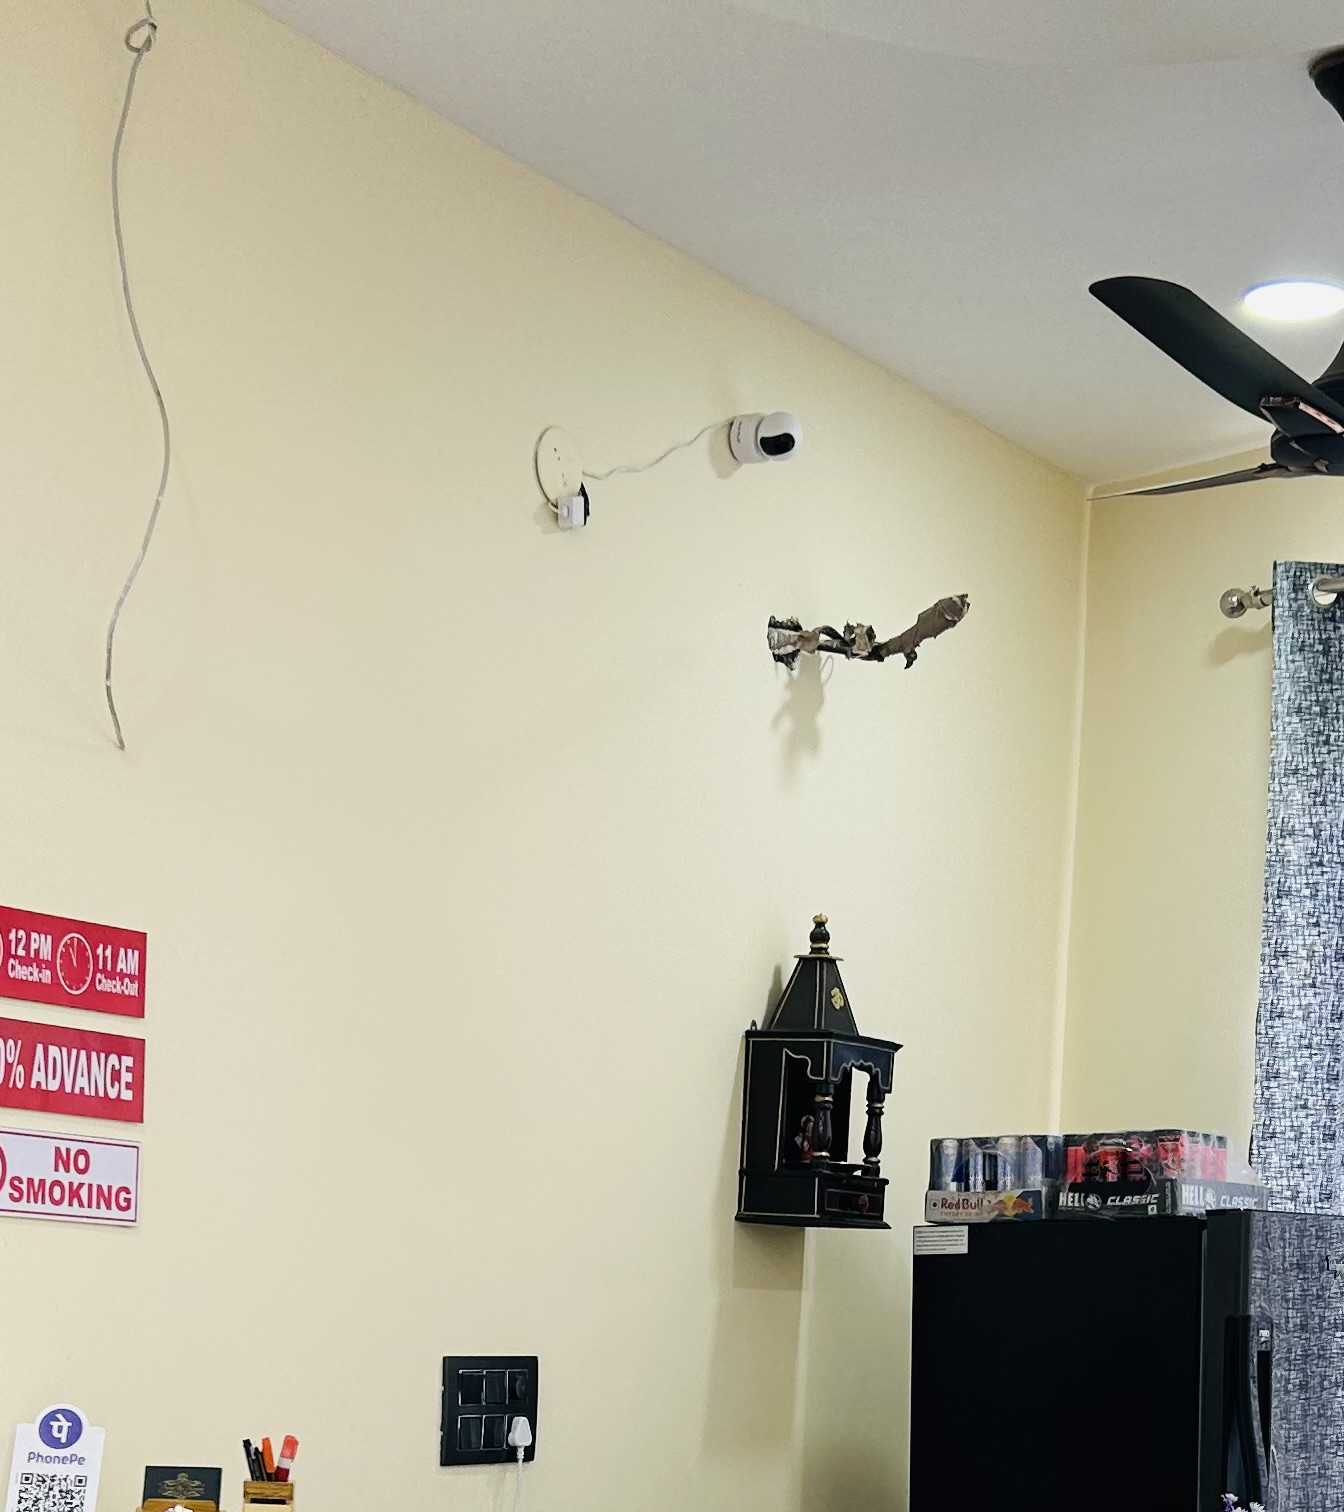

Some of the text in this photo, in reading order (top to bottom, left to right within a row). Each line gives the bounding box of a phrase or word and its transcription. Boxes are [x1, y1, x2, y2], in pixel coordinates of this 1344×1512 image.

[8, 927, 52, 961] 12 PM
[8, 958, 52, 985] Check-in
[96, 944, 139, 976] 11 AM
[95, 973, 139, 997] Check-Out
[31, 1043, 133, 1101] ADVANCE
[54, 1146, 90, 1175] NO
[8, 1176, 132, 1212] SMOKING
[27, 1451, 86, 1466] PhonePe
